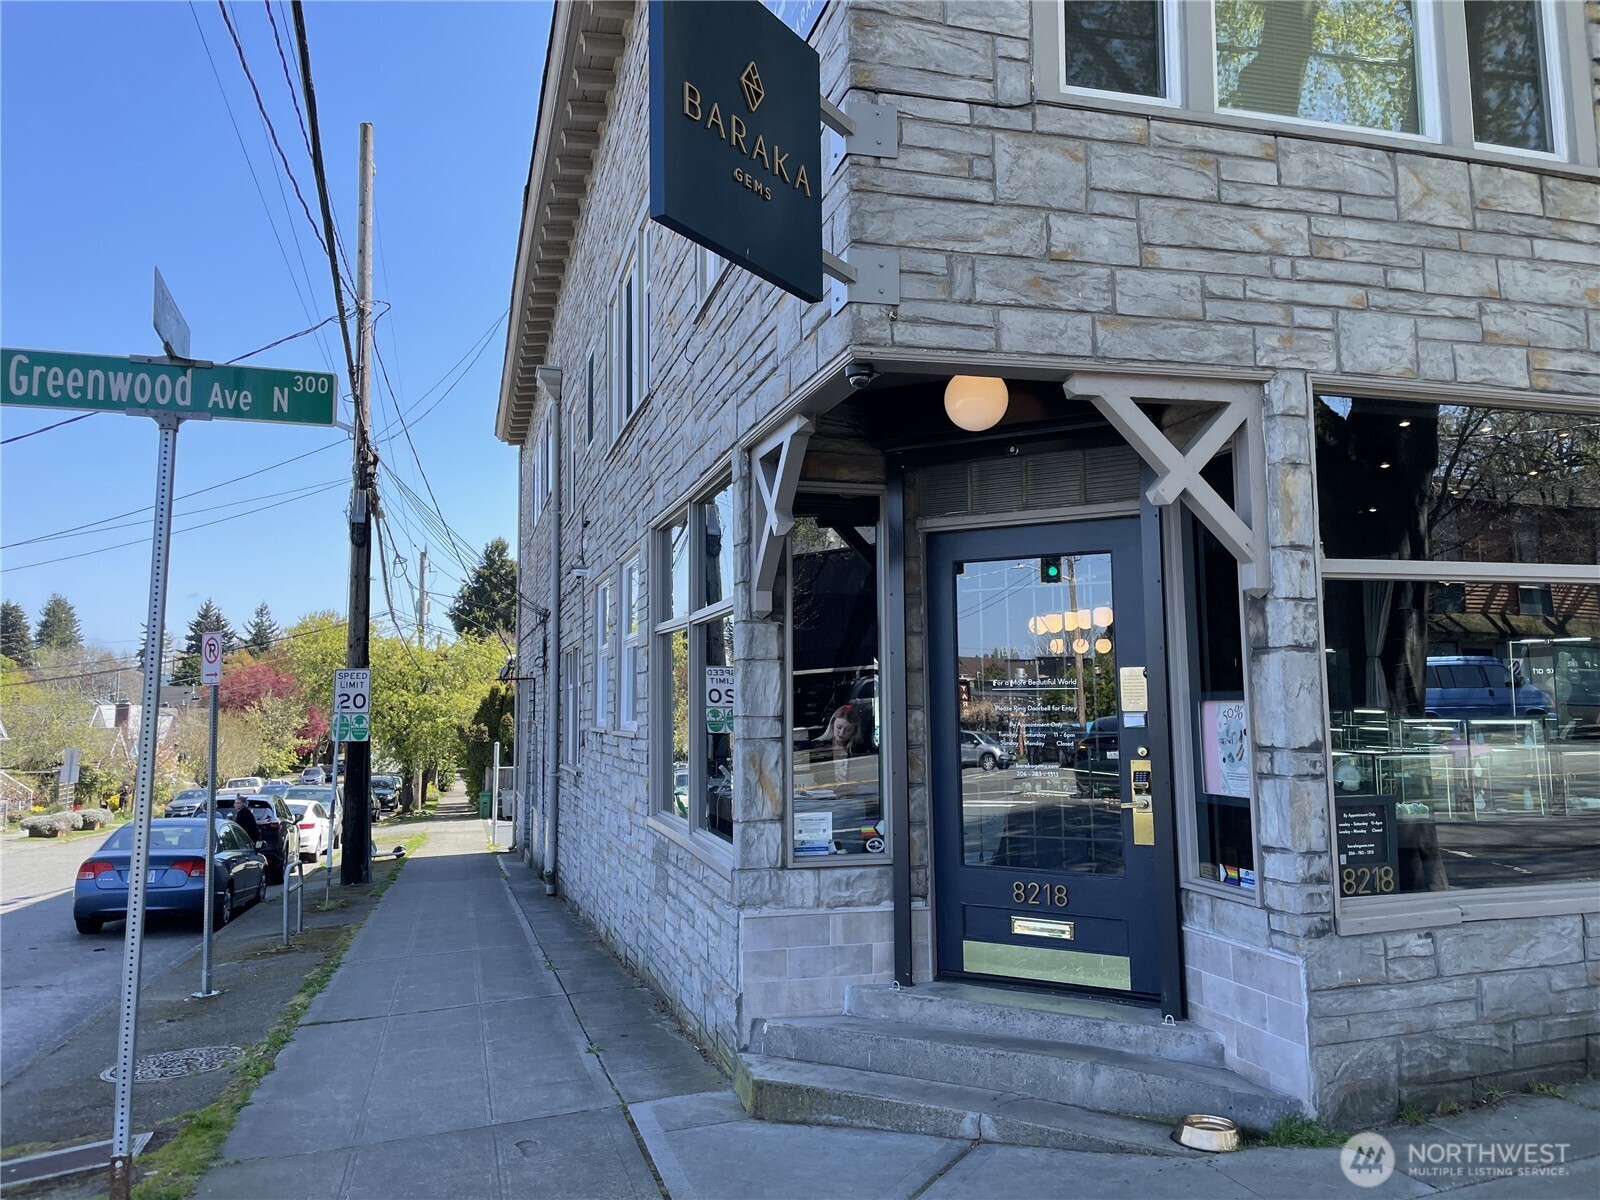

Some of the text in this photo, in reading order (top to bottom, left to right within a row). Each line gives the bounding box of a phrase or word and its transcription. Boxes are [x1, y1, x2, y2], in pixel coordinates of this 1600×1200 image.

[683, 81, 811, 197] BARAKA
[733, 167, 772, 201] GEMS
[9, 355, 329, 413] Greenwood Ave N 300
[338, 672, 368, 680] SPEED
[340, 681, 364, 689] LIMIT
[338, 693, 366, 709] 20
[995, 704, 1078, 713] Please Ring Doorbell for Entry
[1051, 721, 1063, 729] Only
[1222, 704, 1244, 726] 50%
[1343, 866, 1394, 895] 8218
[1013, 881, 1068, 907] 8218
